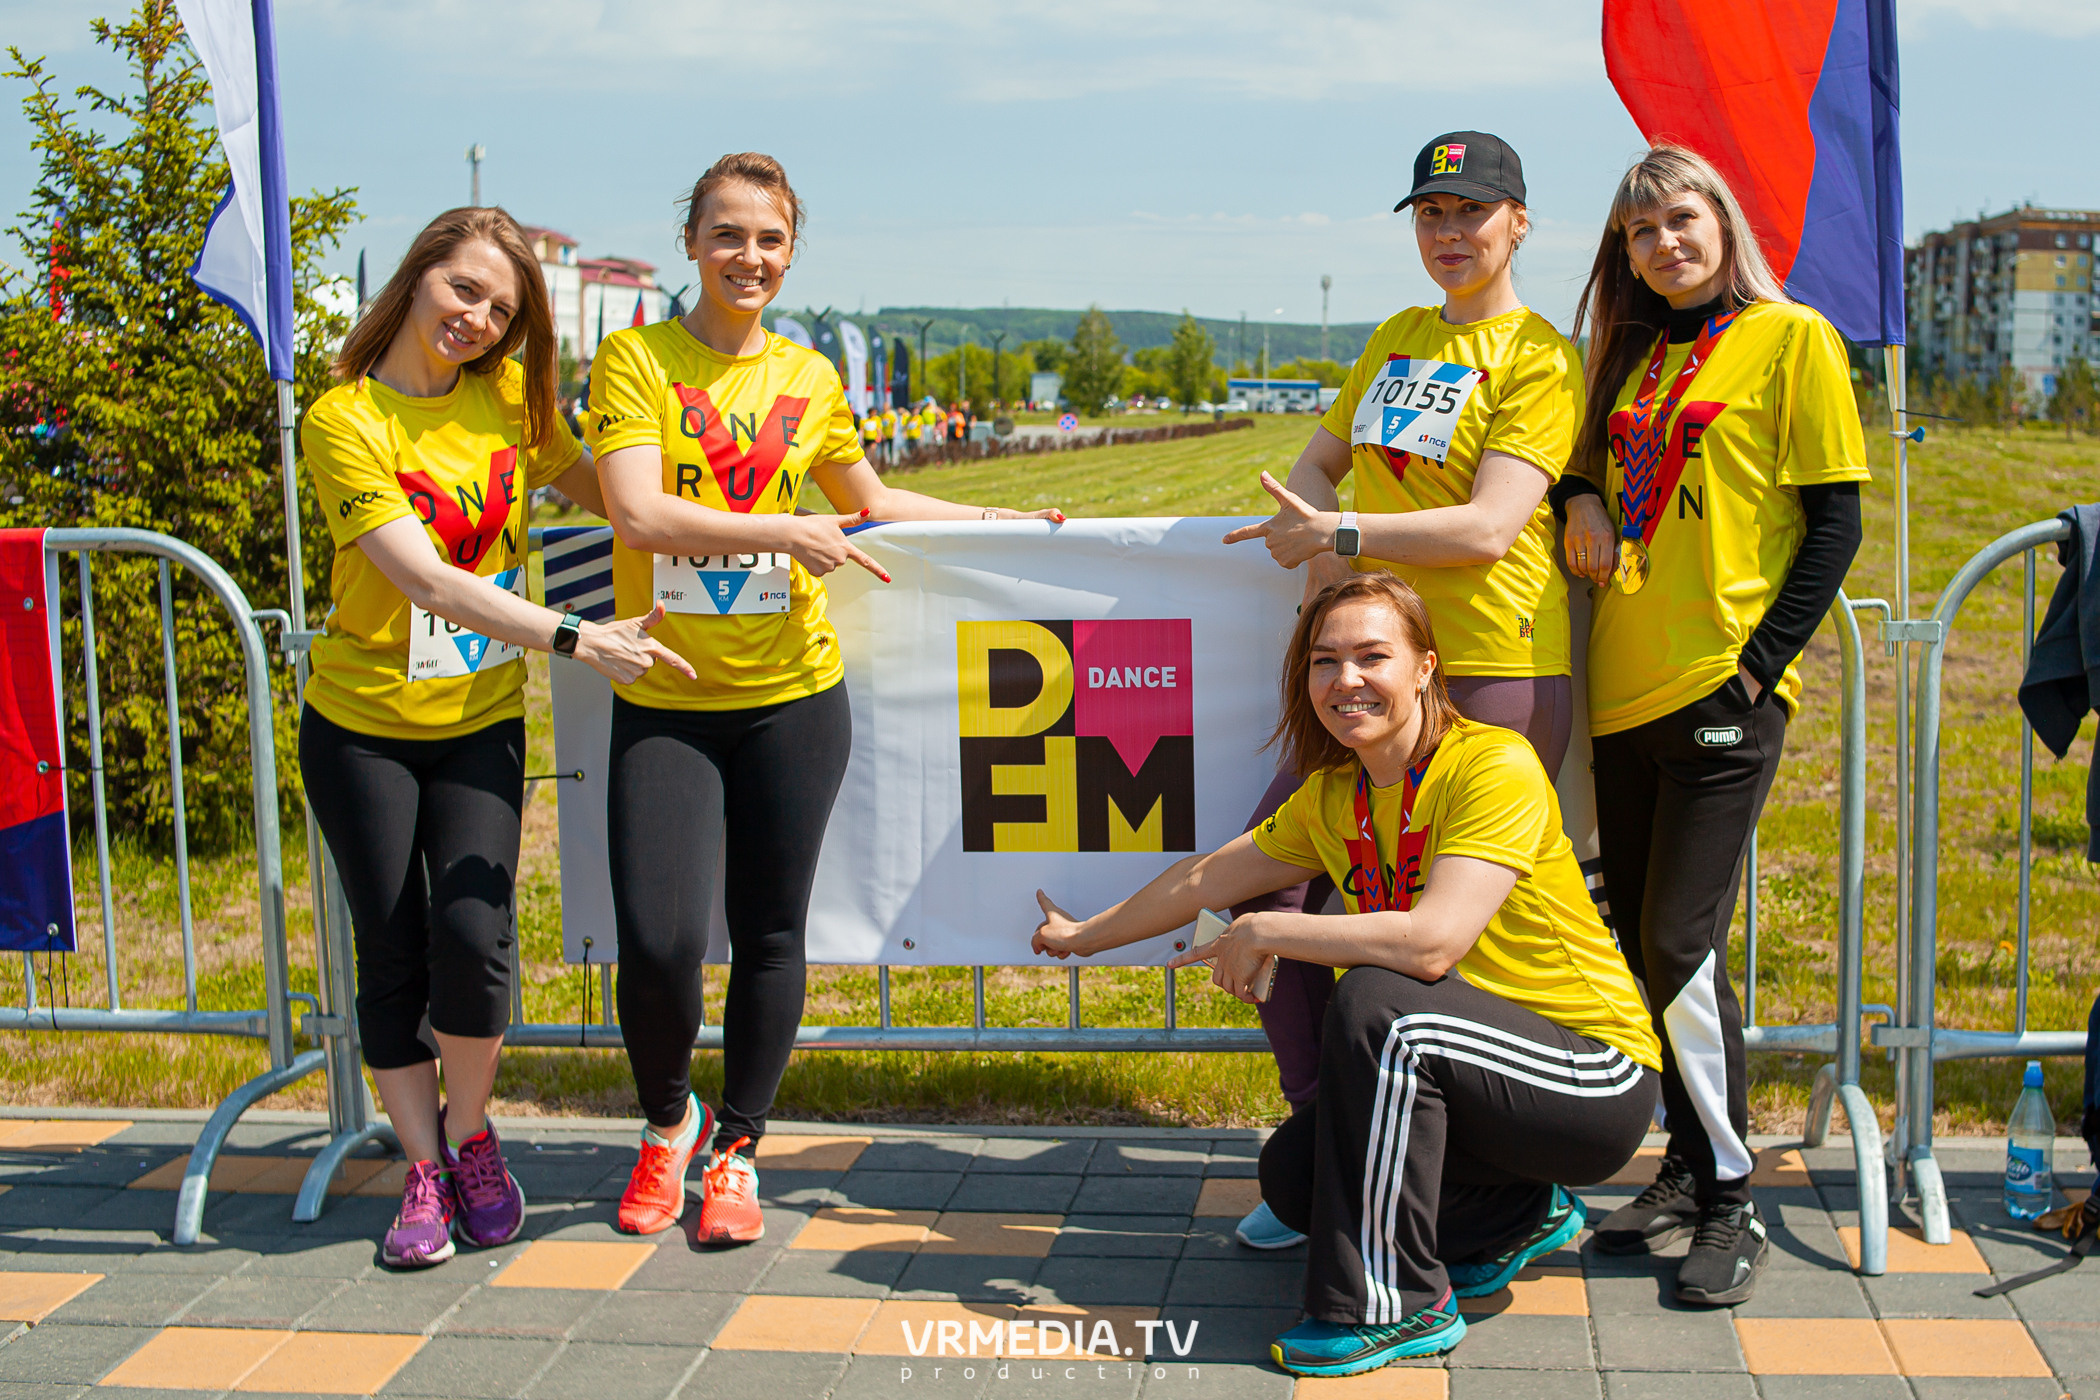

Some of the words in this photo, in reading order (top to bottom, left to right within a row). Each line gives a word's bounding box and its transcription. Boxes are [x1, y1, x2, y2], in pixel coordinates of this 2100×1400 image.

[1371, 379, 1461, 414] 10155
[680, 405, 800, 448] ONE
[1388, 416, 1401, 429] 5
[1429, 437, 1447, 448] ПСБ
[676, 463, 799, 503] RUN
[409, 470, 518, 525] ONE
[718, 580, 730, 596] 5
[770, 592, 787, 600] ПСБ
[469, 639, 479, 656] 5
[1088, 667, 1177, 689] DANCE
[1704, 730, 1736, 743] PUMA
